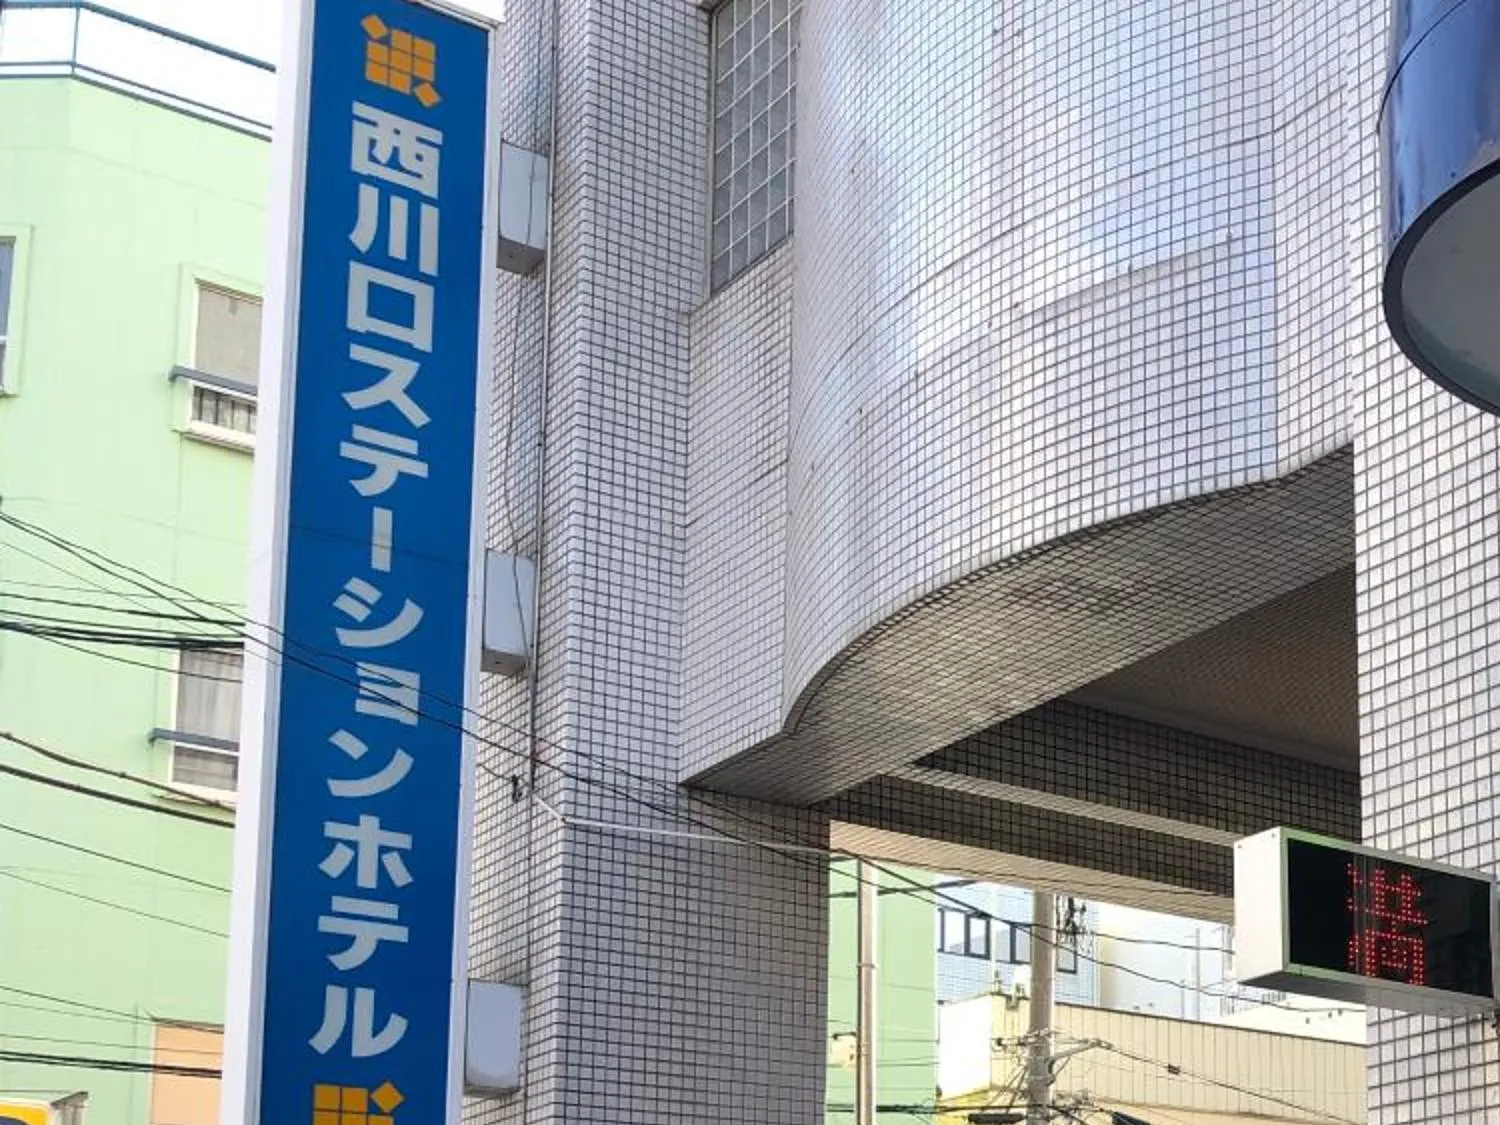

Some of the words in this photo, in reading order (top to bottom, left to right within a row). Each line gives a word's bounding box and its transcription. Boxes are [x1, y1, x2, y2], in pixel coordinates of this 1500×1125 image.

[309, 100, 443, 1059] 西川口ステーションホテル
